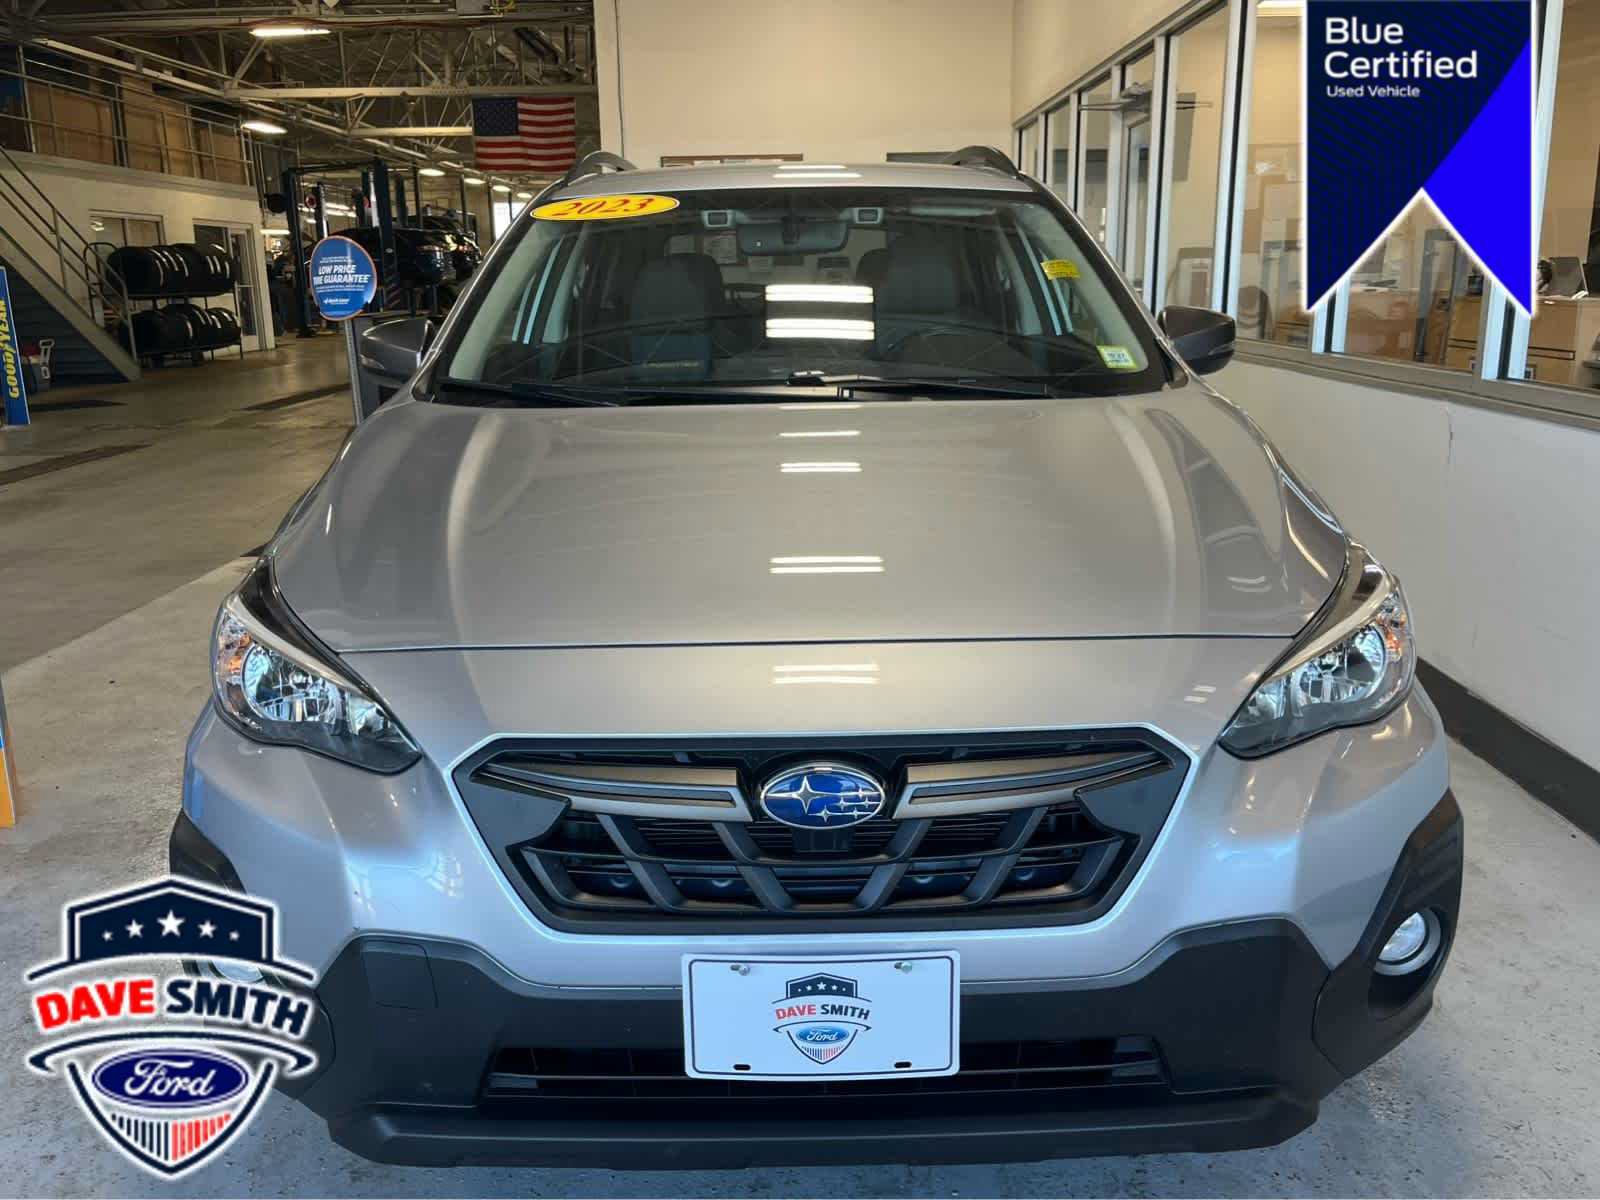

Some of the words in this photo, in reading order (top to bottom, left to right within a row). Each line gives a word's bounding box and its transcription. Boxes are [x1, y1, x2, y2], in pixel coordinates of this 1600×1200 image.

[552, 198, 655, 216] 2023
[318, 265, 333, 274] LOW
[333, 264, 356, 273] PRICE
[324, 274, 369, 283] GUARANTEE
[775, 1004, 817, 1020] DAVE
[820, 1003, 870, 1020] SMITH
[806, 1028, 839, 1041] Ford
